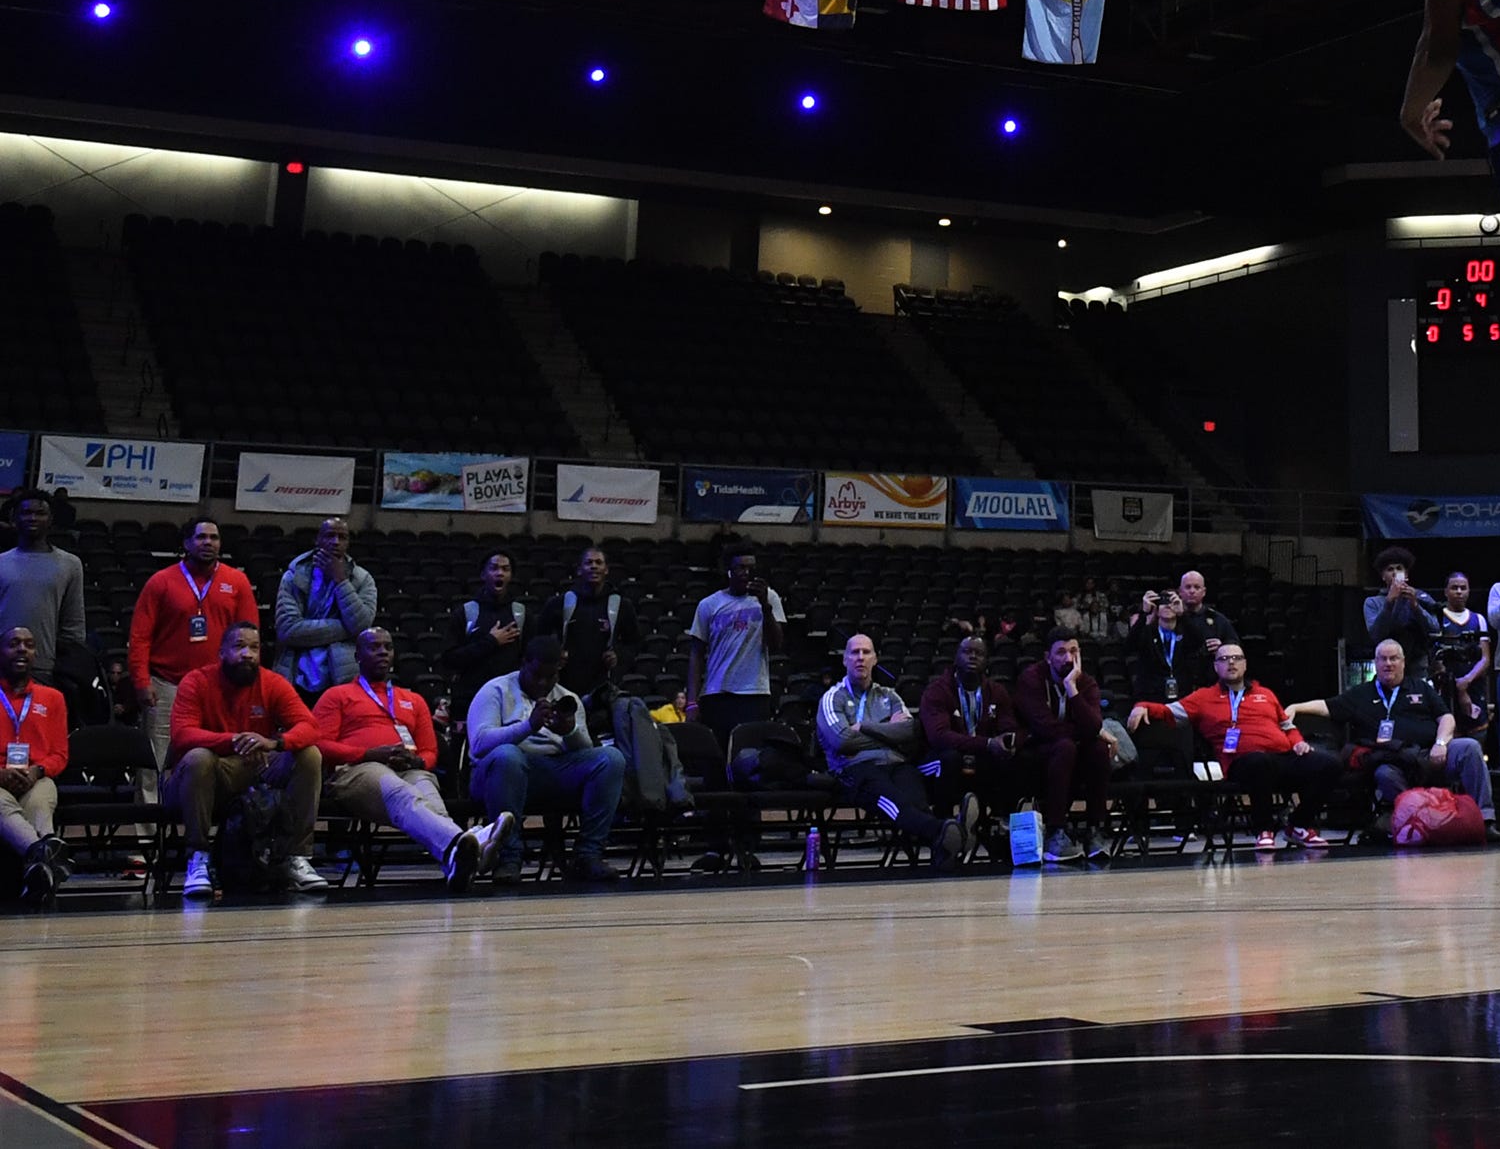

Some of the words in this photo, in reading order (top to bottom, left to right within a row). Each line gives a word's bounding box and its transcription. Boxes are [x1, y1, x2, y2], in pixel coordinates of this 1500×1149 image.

[1474, 292, 1488, 308] 4
[1462, 323, 1475, 342] 5
[1489, 323, 1500, 341] 5
[107, 444, 155, 470] PHI
[466, 468, 512, 485] PLAYA
[274, 485, 344, 496] PIEDMONT
[474, 481, 525, 500] BOWLS
[712, 484, 766, 495] TidalHealth
[828, 496, 866, 512] Arby's
[972, 495, 1051, 517] MOOLAH
